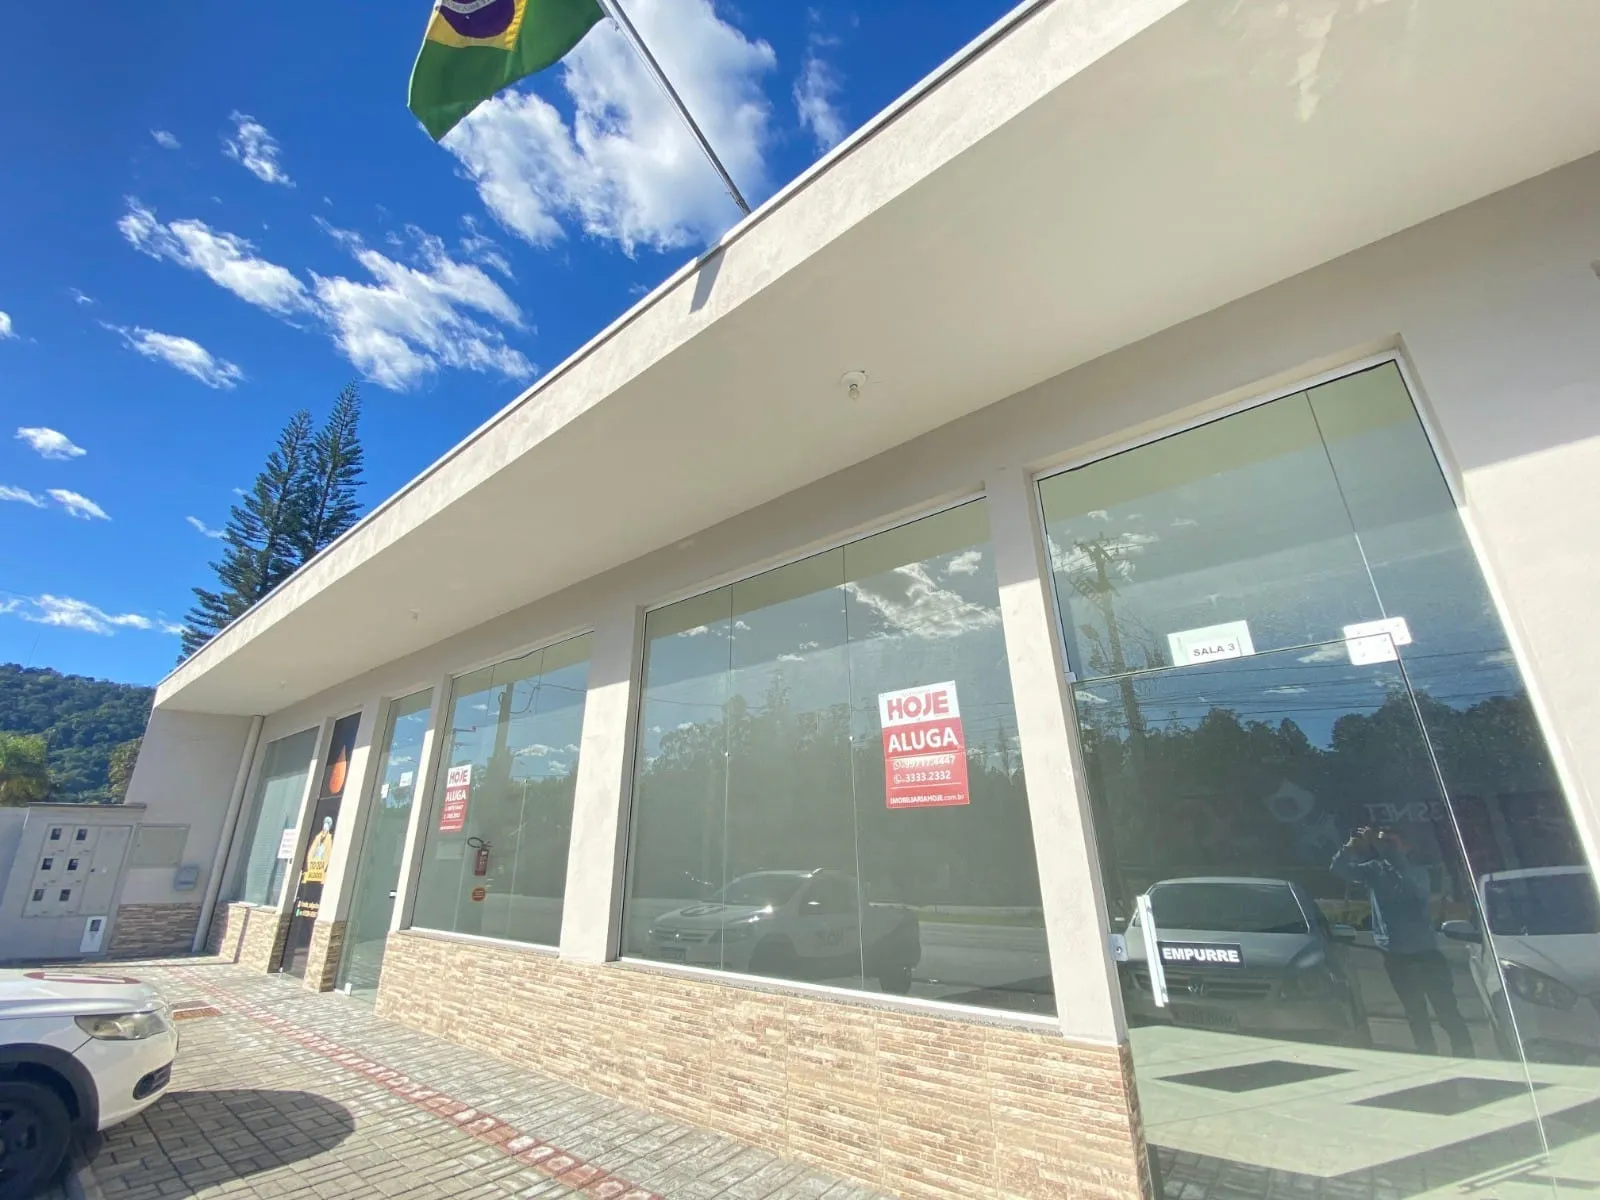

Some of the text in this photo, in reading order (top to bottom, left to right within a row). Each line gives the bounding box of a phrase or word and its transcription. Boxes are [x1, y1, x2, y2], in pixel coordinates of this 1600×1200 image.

[1193, 643, 1236, 657] SALA 3
[886, 690, 949, 720] HOJE
[888, 727, 959, 753] ALUGA
[448, 769, 468, 785] HOJE
[905, 770, 952, 783] 3333.2332
[445, 789, 467, 802] ALUGA
[1161, 947, 1240, 963] EMPURRE
